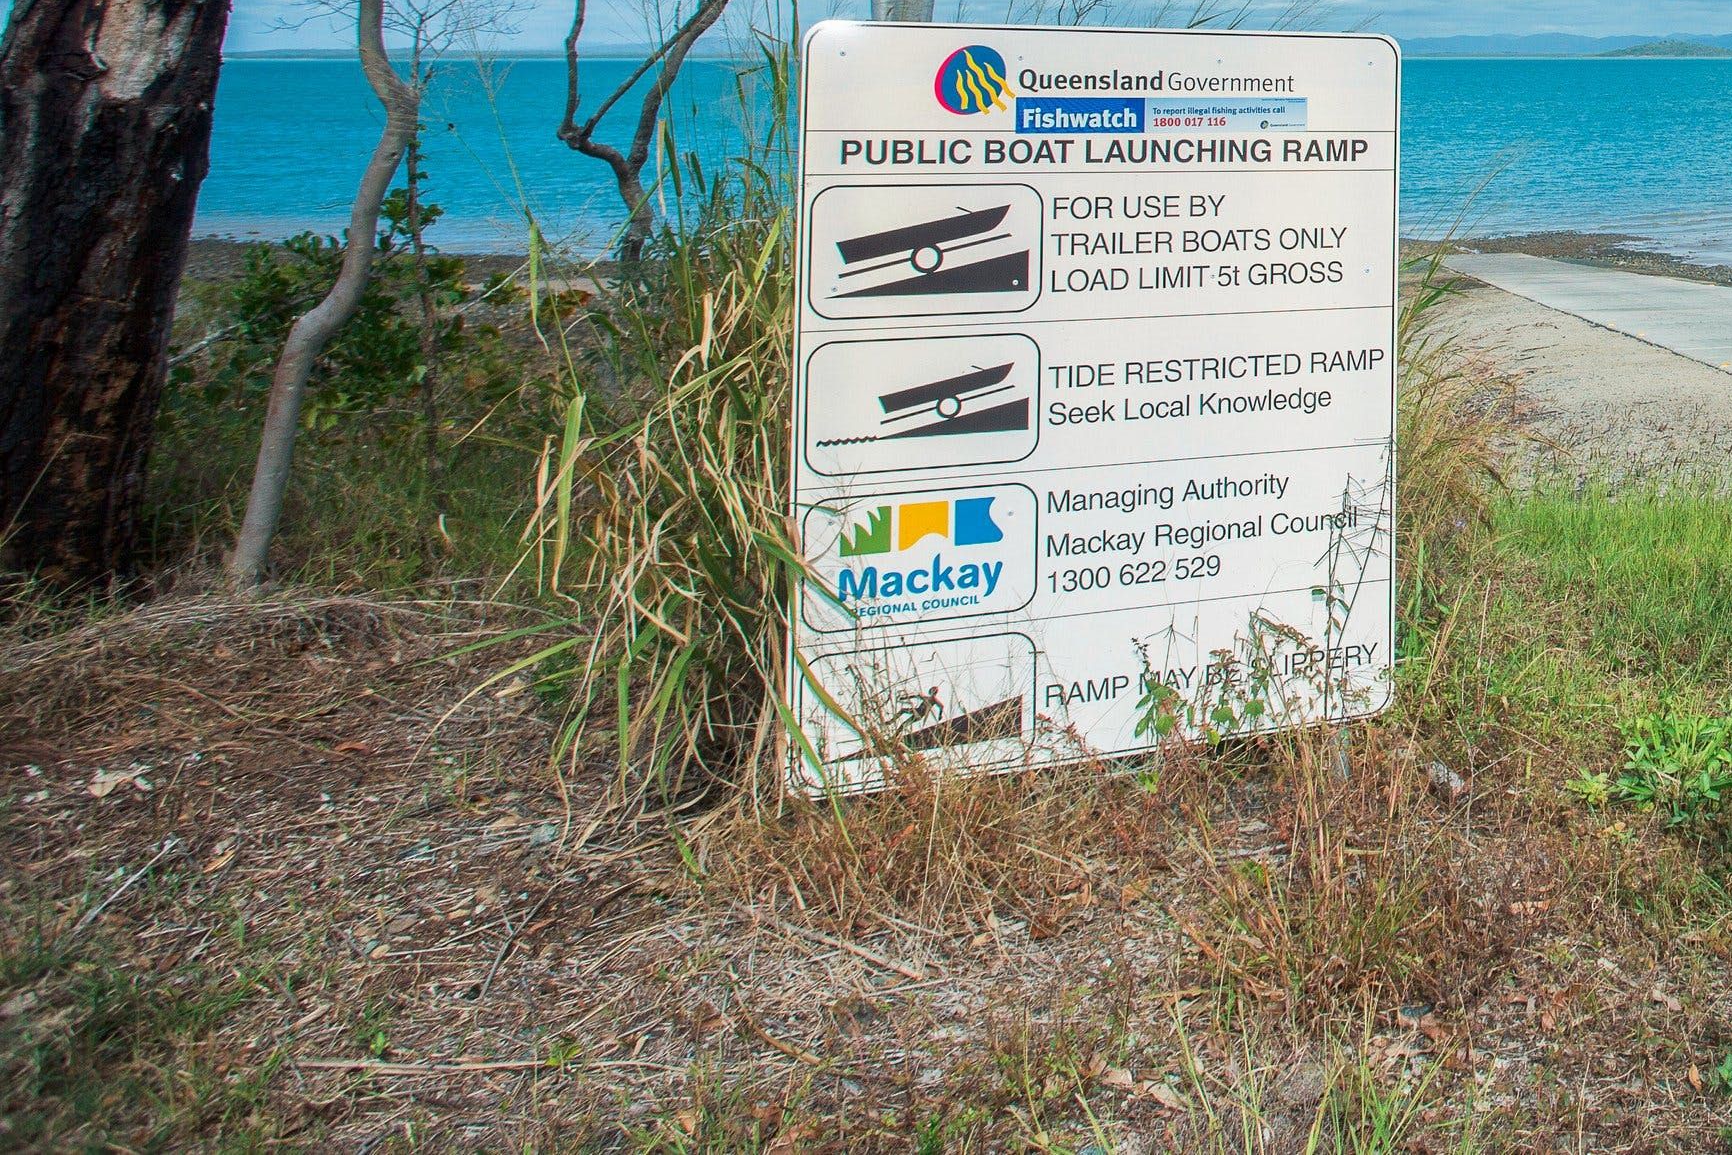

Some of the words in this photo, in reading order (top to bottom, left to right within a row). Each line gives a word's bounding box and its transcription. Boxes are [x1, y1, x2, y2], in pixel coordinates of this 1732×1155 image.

[1019, 69, 1163, 92] Queensland
[1168, 72, 1294, 92] Government
[1022, 107, 1137, 129] Fishwatch
[1153, 107, 1161, 115] To
[1163, 108, 1186, 117] report
[1187, 107, 1211, 117] illegal
[1212, 106, 1237, 116] fishing
[1238, 106, 1271, 114] activities
[1272, 106, 1285, 114] call
[1153, 117, 1181, 127] 1800
[1184, 117, 1203, 127] 017
[1207, 116, 1226, 127] 116
[840, 139, 972, 166] PUBLIC
[983, 139, 1074, 166] BOAT
[1085, 138, 1272, 164] LAUNCHING
[1282, 138, 1369, 163] RAMP
[1052, 196, 1113, 220] FOR
[1123, 195, 1180, 219] USE
[1189, 195, 1226, 217] BY
[1051, 231, 1173, 256] TRAILER
[1182, 228, 1271, 253] BOATS
[1279, 227, 1347, 250] ONLY
[1051, 268, 1129, 292] LOAD
[1139, 265, 1210, 290] LIMIT
[1217, 265, 1240, 288] 5t
[1248, 261, 1344, 286] GROSS
[1048, 363, 1115, 389] TIDE
[1125, 353, 1302, 385] RESTRICTED
[1310, 348, 1385, 374] RAMP
[1048, 399, 1116, 425] Seek
[1125, 394, 1190, 420] Local
[1199, 387, 1332, 415] Knowledge
[1048, 483, 1174, 514] Managing
[1182, 473, 1290, 502] Authority
[1047, 530, 1145, 557] Mackay
[1155, 515, 1262, 549] Regional
[1270, 506, 1357, 535] Council
[838, 553, 1003, 602] Mackay
[1048, 566, 1111, 594] 1300
[1119, 560, 1167, 586] 622
[1174, 554, 1222, 580] 529
[922, 596, 980, 610] COUNCIL
[1045, 675, 1129, 707] RAMP
